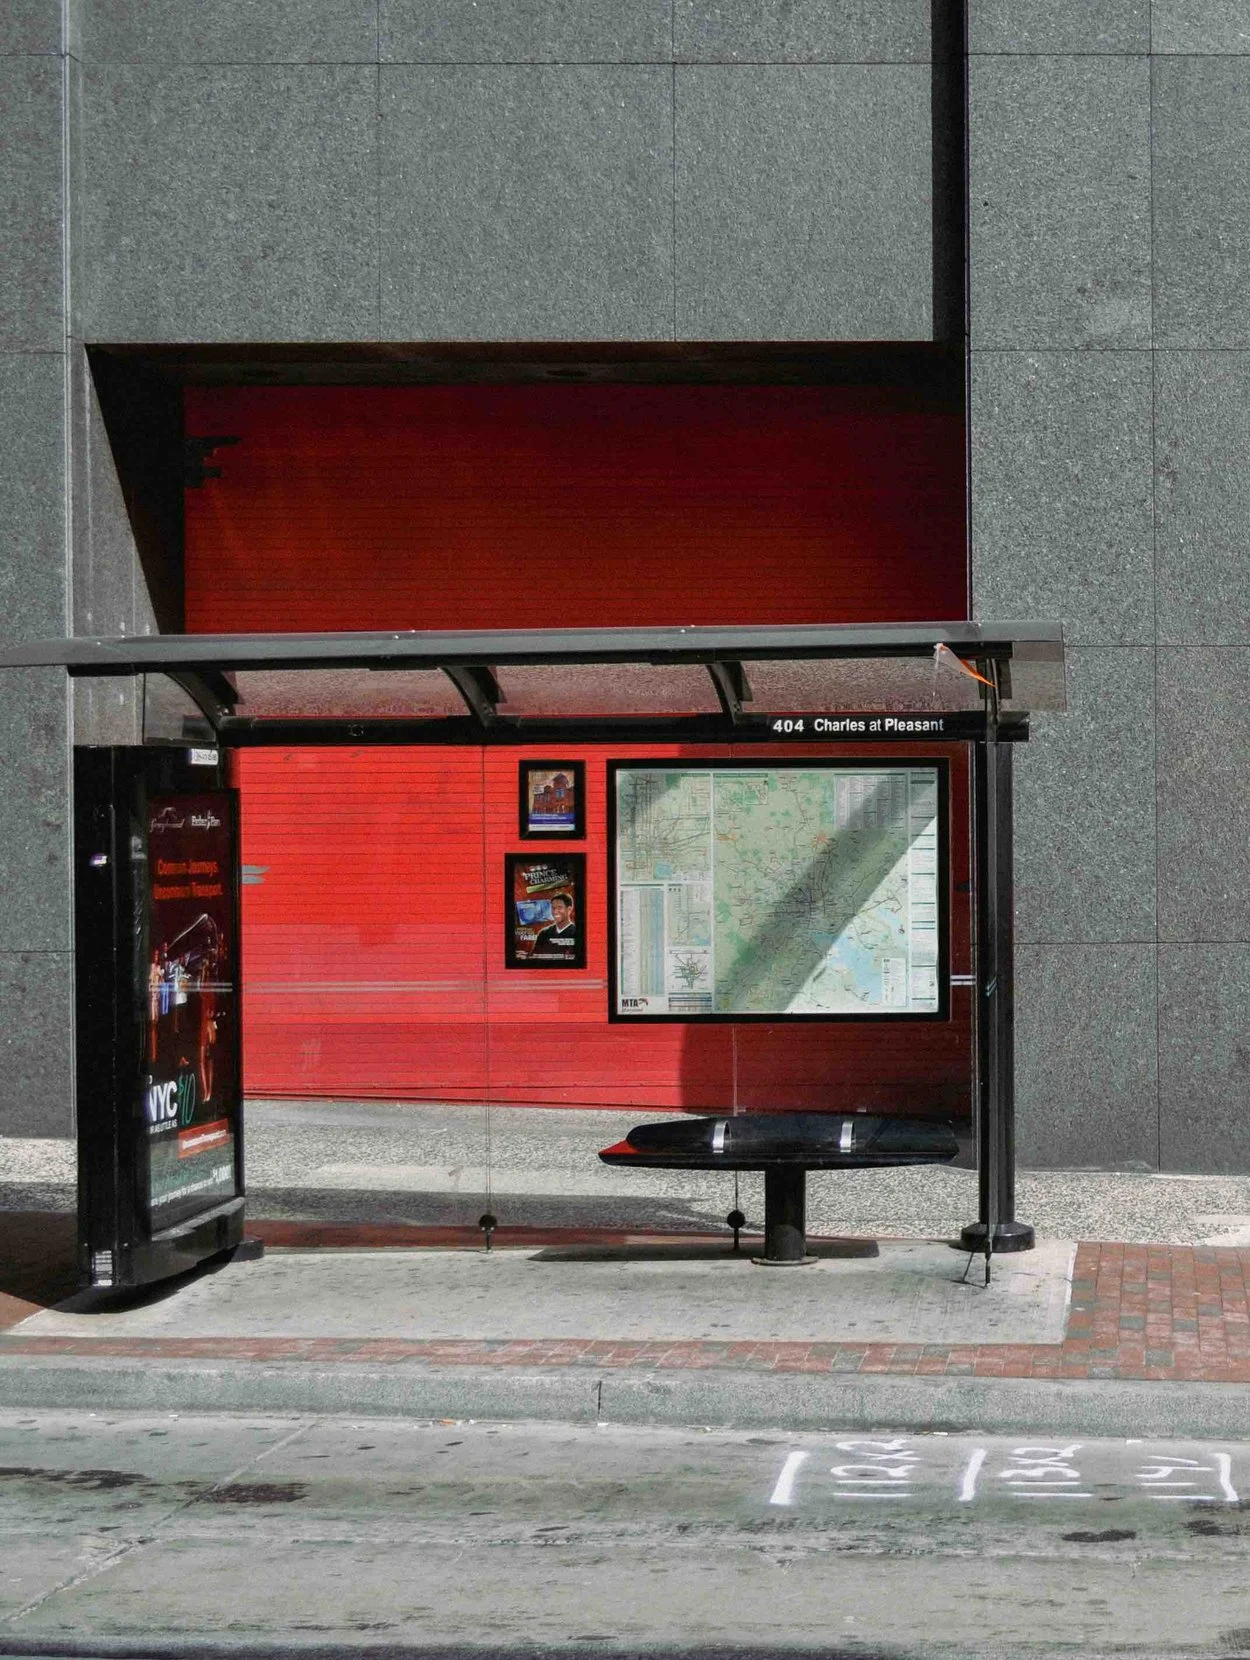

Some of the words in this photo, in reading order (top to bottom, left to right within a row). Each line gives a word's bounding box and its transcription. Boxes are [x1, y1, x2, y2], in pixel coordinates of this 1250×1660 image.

[772, 719, 804, 733] 404
[814, 718, 866, 732] Charles
[869, 719, 881, 732] at
[885, 718, 944, 732] Pleasant
[524, 869, 557, 881] PRINCE
[530, 874, 568, 885] CHARMING
[621, 998, 639, 1008] MTA
[149, 1081, 178, 1122] NYC
